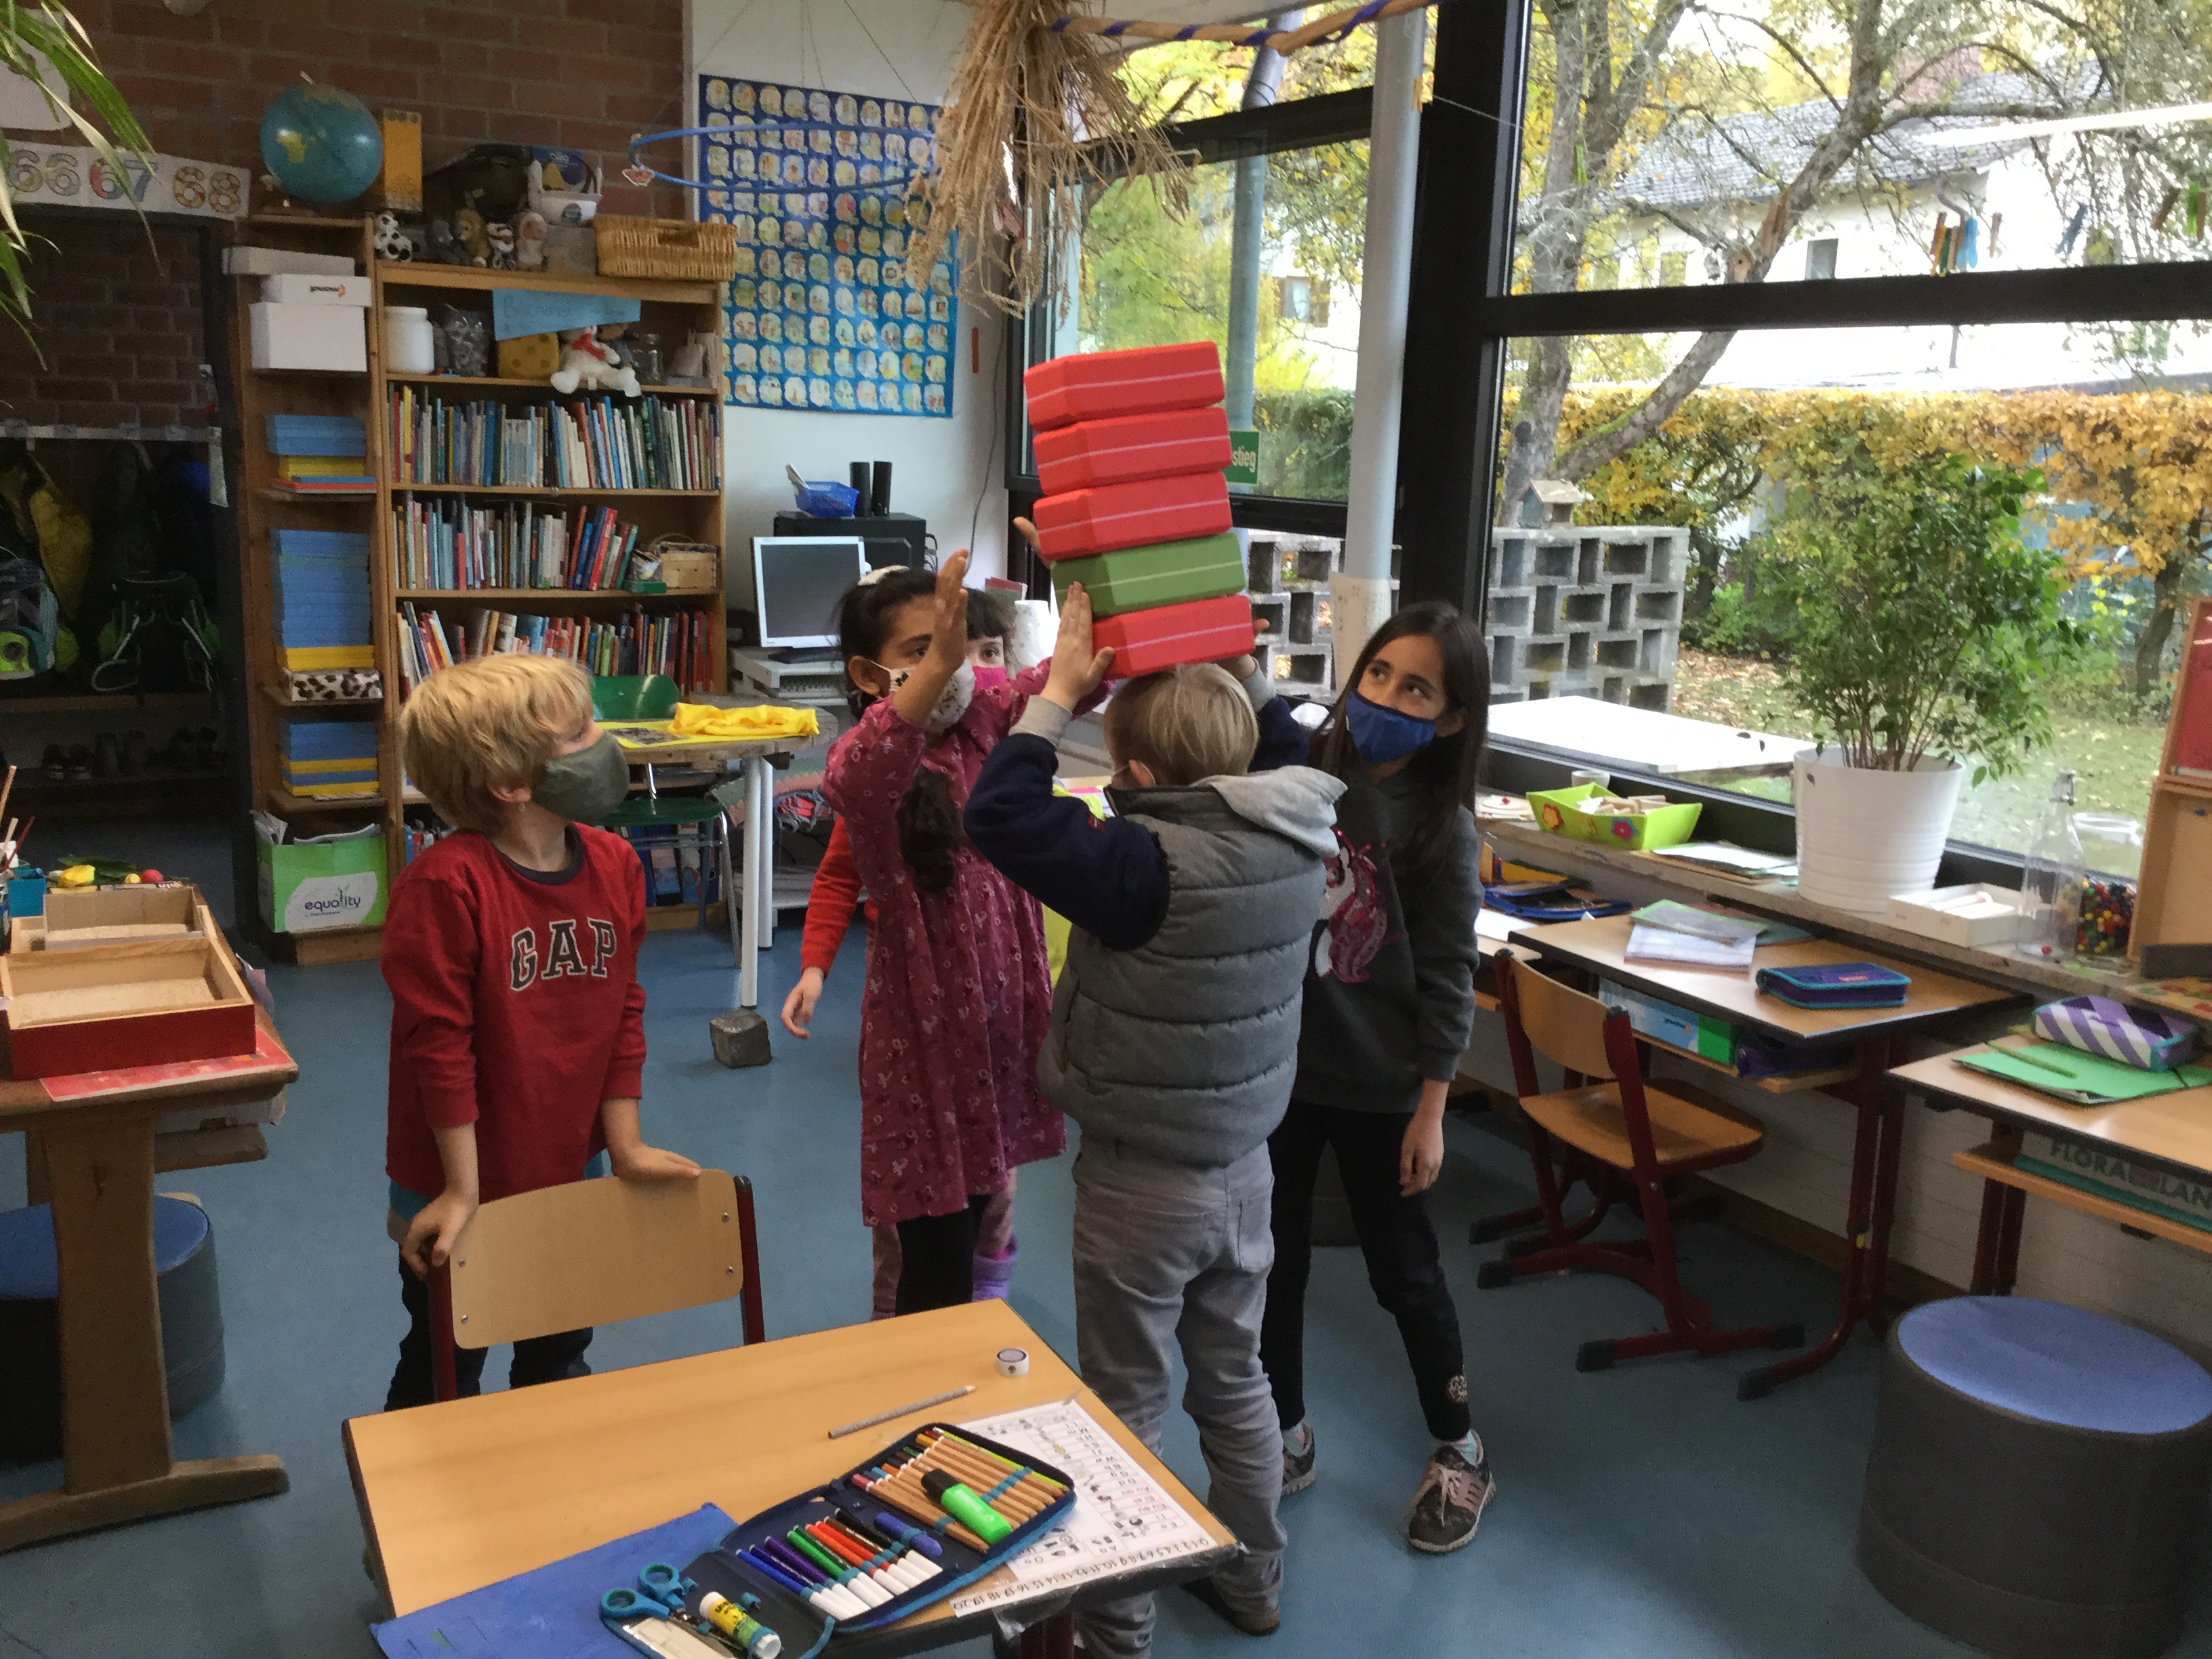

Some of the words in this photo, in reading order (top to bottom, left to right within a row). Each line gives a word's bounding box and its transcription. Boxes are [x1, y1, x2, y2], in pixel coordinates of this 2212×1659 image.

[89, 157, 159, 203] 67
[172, 166, 241, 214] 68
[304, 888, 361, 912] equality
[510, 916, 617, 992] GAP
